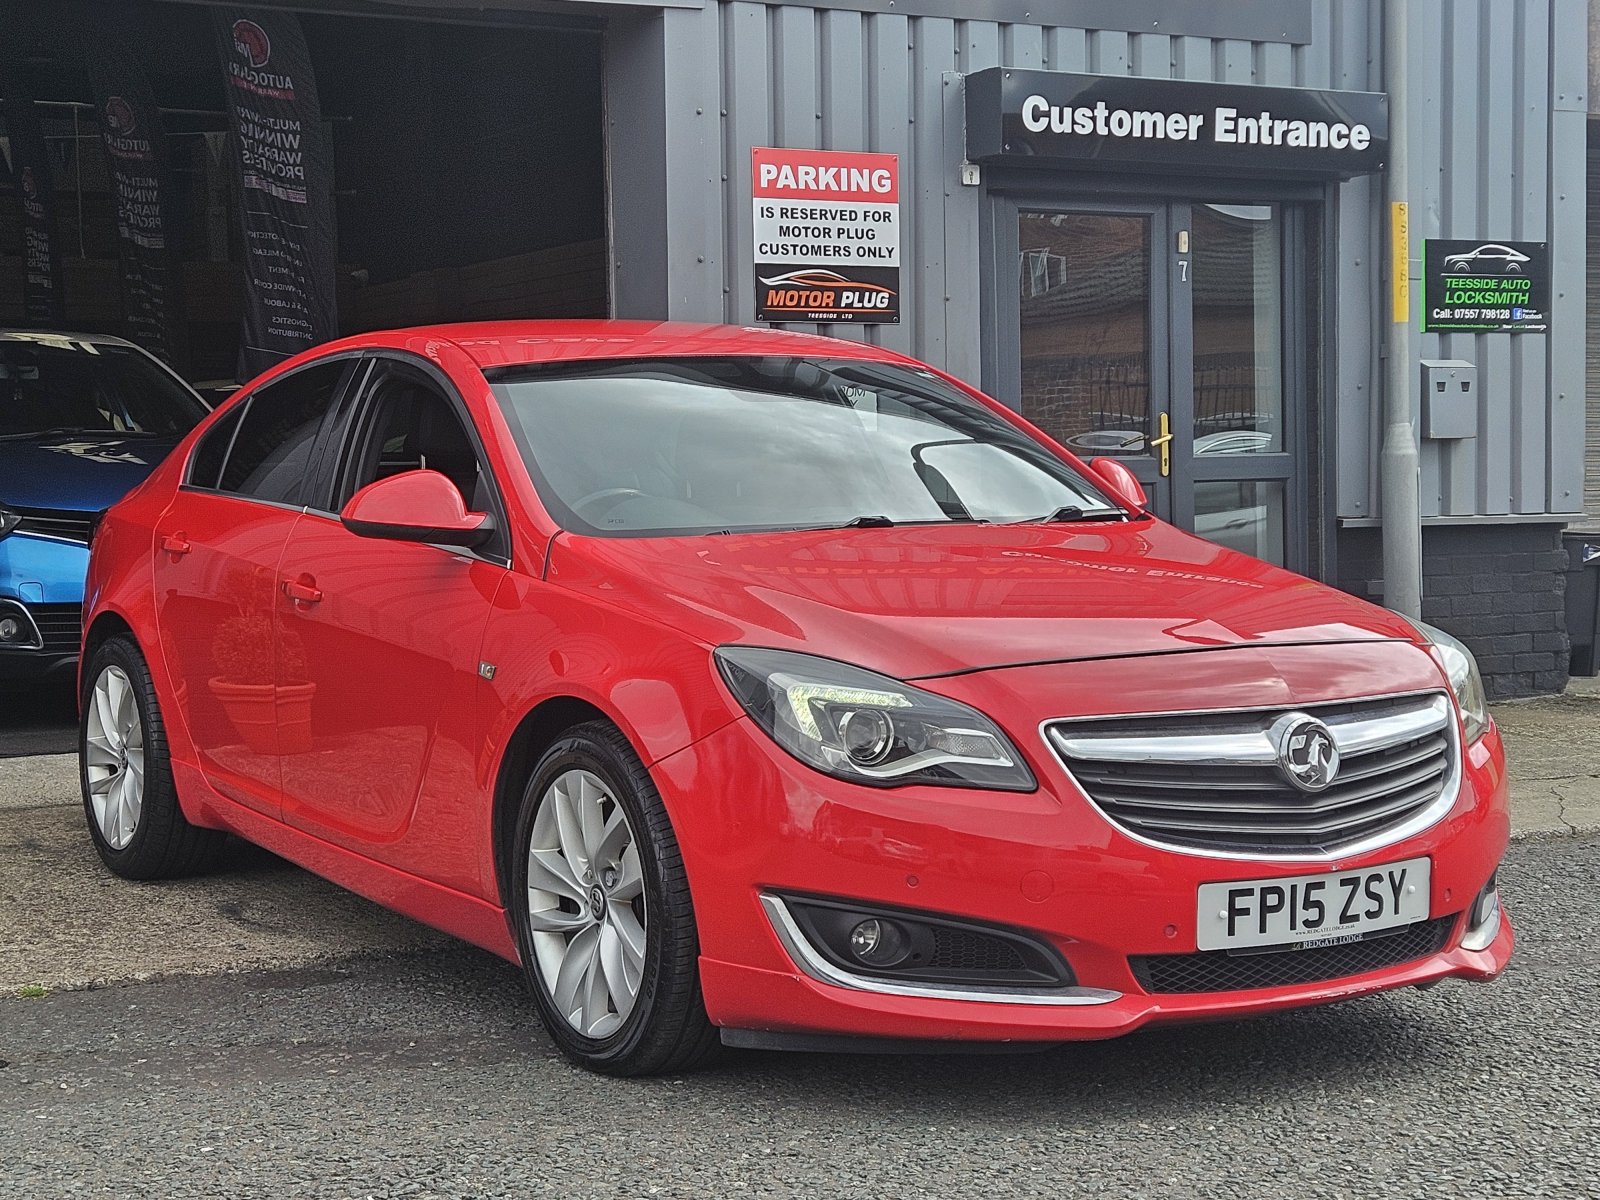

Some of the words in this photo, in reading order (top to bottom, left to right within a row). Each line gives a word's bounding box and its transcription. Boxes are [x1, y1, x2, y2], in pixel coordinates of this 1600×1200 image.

[1022, 95, 1203, 140] Customer
[1215, 107, 1371, 150] Entrance
[760, 163, 892, 194] PARKING
[760, 206, 775, 219] IS
[780, 207, 858, 222] RESERVED
[863, 210, 892, 223] FOR
[779, 225, 832, 239] MOTOR
[837, 227, 876, 240] PLUG
[759, 243, 852, 258] CUSTOMERS
[856, 246, 895, 259] ONLY
[1178, 261, 1188, 282] 7
[1446, 278, 1499, 289] TEESSIDE
[1500, 279, 1531, 290] AUTO
[767, 290, 835, 307] MOTOR
[841, 291, 890, 308] PLUG
[1444, 291, 1529, 305] LOCKSMITH
[1433, 308, 1453, 319] Call:
[1454, 308, 1479, 319] 07557
[1481, 309, 1511, 319] 798128
[1227, 881, 1326, 937] FP15
[1339, 868, 1407, 925] ZSY
[1302, 937, 1339, 949] REDGATE
[1340, 933, 1364, 945] LODGE
